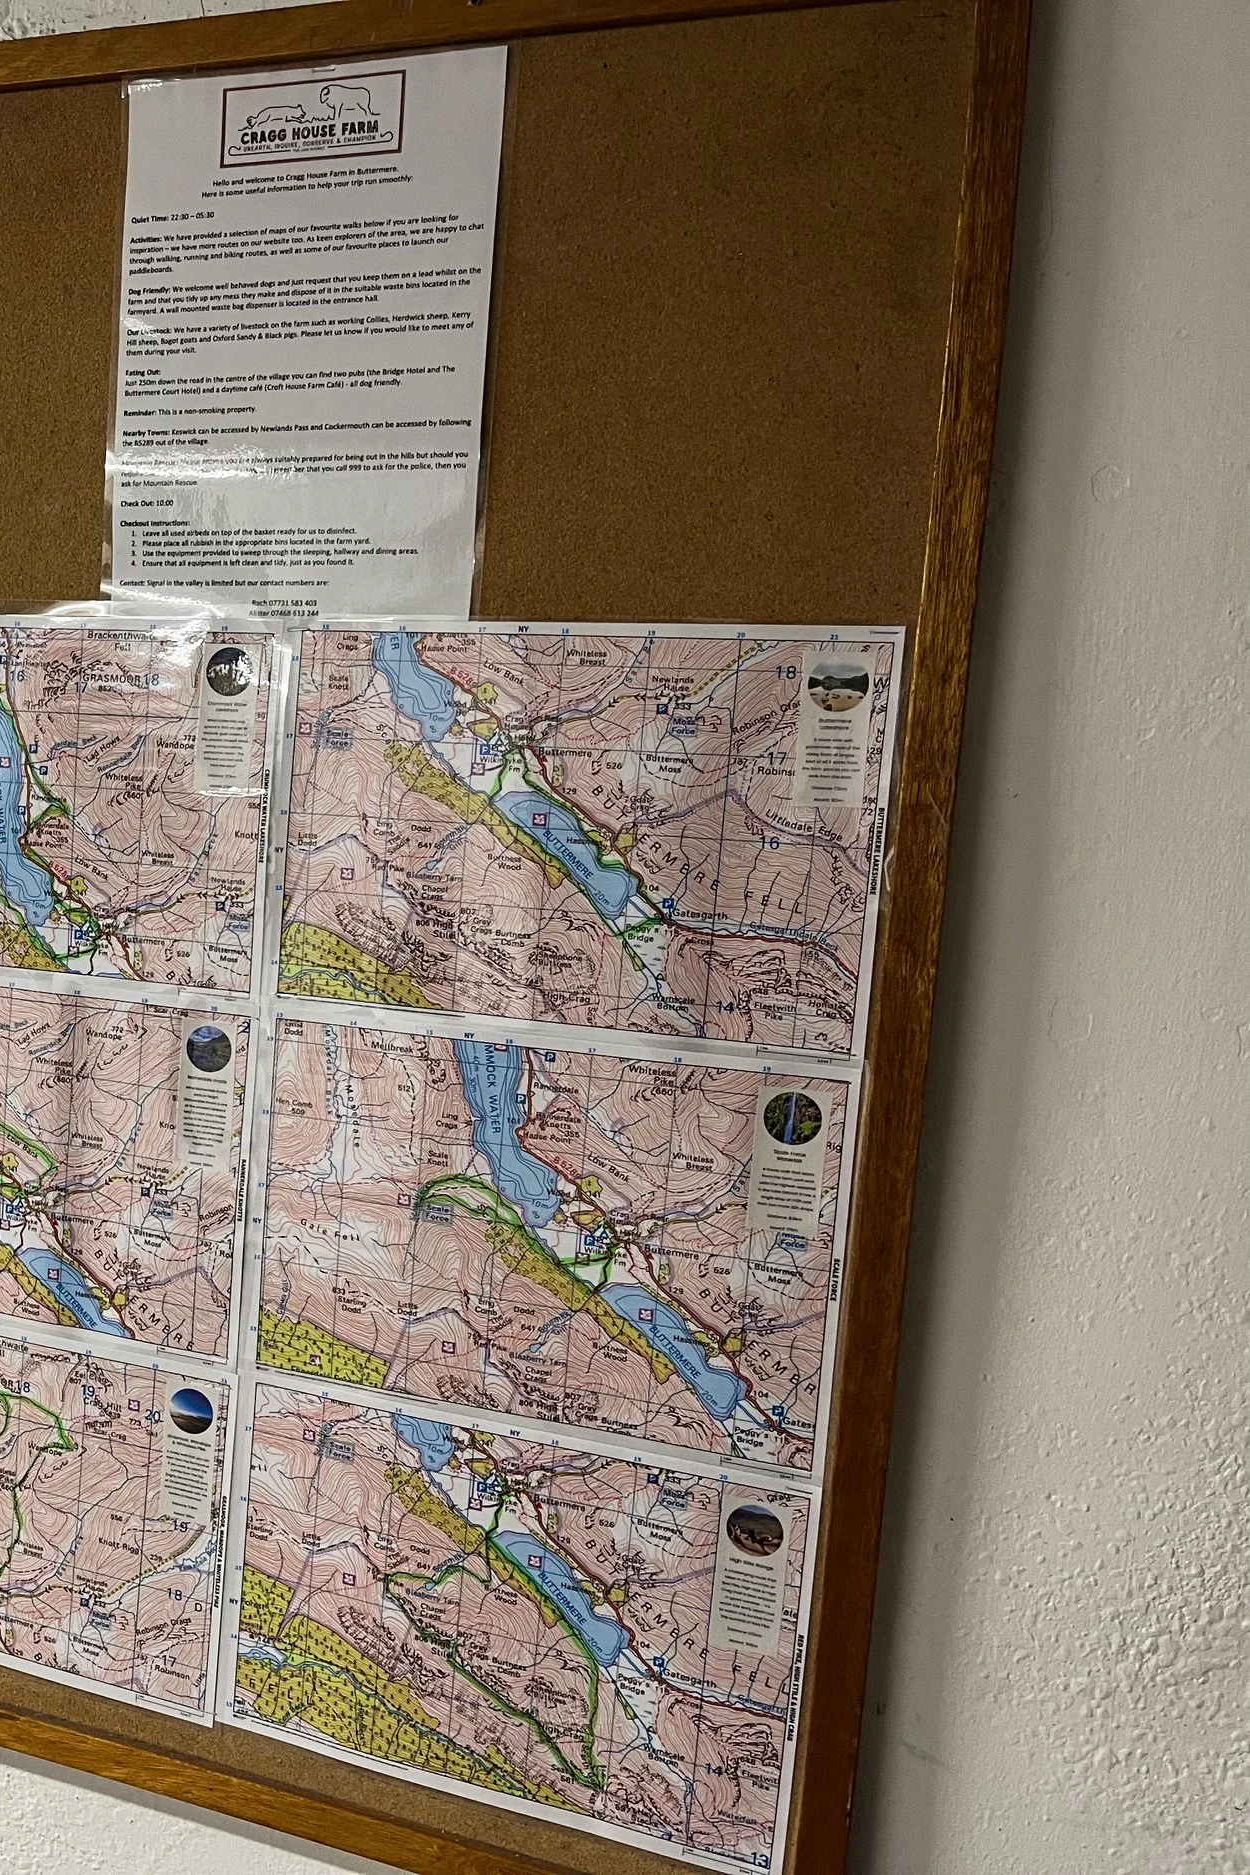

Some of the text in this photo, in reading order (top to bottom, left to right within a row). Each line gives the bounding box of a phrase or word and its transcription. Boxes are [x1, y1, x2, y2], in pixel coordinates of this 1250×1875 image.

[241, 120, 378, 144] CRAGG HOUSE FARM
[201, 190, 217, 198] Here
[244, 186, 266, 195] useful
[266, 183, 307, 193] information
[316, 181, 332, 191] help
[333, 181, 350, 189] your
[350, 178, 363, 188] trip
[378, 174, 413, 186] smoothly:
[212, 179, 230, 187] Hello
[245, 175, 275, 184] welcome
[285, 172, 305, 183] Cragg
[306, 170, 328, 179] House
[329, 169, 347, 177] Farm
[356, 164, 398, 175] Buttermere.
[130, 216, 149, 224] Quiet
[151, 214, 169, 222] Time:
[170, 213, 189, 221] 22:30
[195, 211, 214, 219] 05:30
[130, 236, 162, 244] Activities:
[175, 233, 192, 241] have
[192, 231, 222, 242] provided
[228, 228, 259, 237] selection
[268, 228, 287, 236] maps
[310, 222, 341, 231] favourite
[342, 221, 362, 229] walks
[363, 219, 385, 227] below
[392, 219, 406, 227] you
[420, 214, 447, 225] looking
[448, 213, 459, 221] for
[123, 409, 156, 417] Reminder:
[183, 406, 225, 416] non-smoking
[226, 406, 255, 414] property.
[122, 429, 146, 438] Nearby
[250, 425, 259, 434] by
[260, 424, 292, 432] Newlands
[324, 422, 370, 430] Cockermouth
[428, 419, 437, 428] by
[438, 418, 472, 428] following
[187, 437, 209, 446] village.
[276, 528, 296, 537] ready
[82, 674, 140, 684] GRASMOOR
[156, 740, 195, 750] Wandope
[260, 805, 268, 827] WATER
[766, 808, 842, 842] Littledale Edge
[258, 828, 266, 864] LAKESHORE
[543, 830, 594, 880] BUTTERMERE
[870, 808, 885, 895] BUTTERMERE LAKESHORE
[672, 908, 728, 920] Gatesgarth
[830, 1258, 840, 1302] SCALE FORCE
[649, 1324, 702, 1380] BUTTERMERE
[537, 1572, 588, 1626] BUTTERMERE
[796, 1634, 804, 1648] RED
[791, 1682, 799, 1701] STILE
